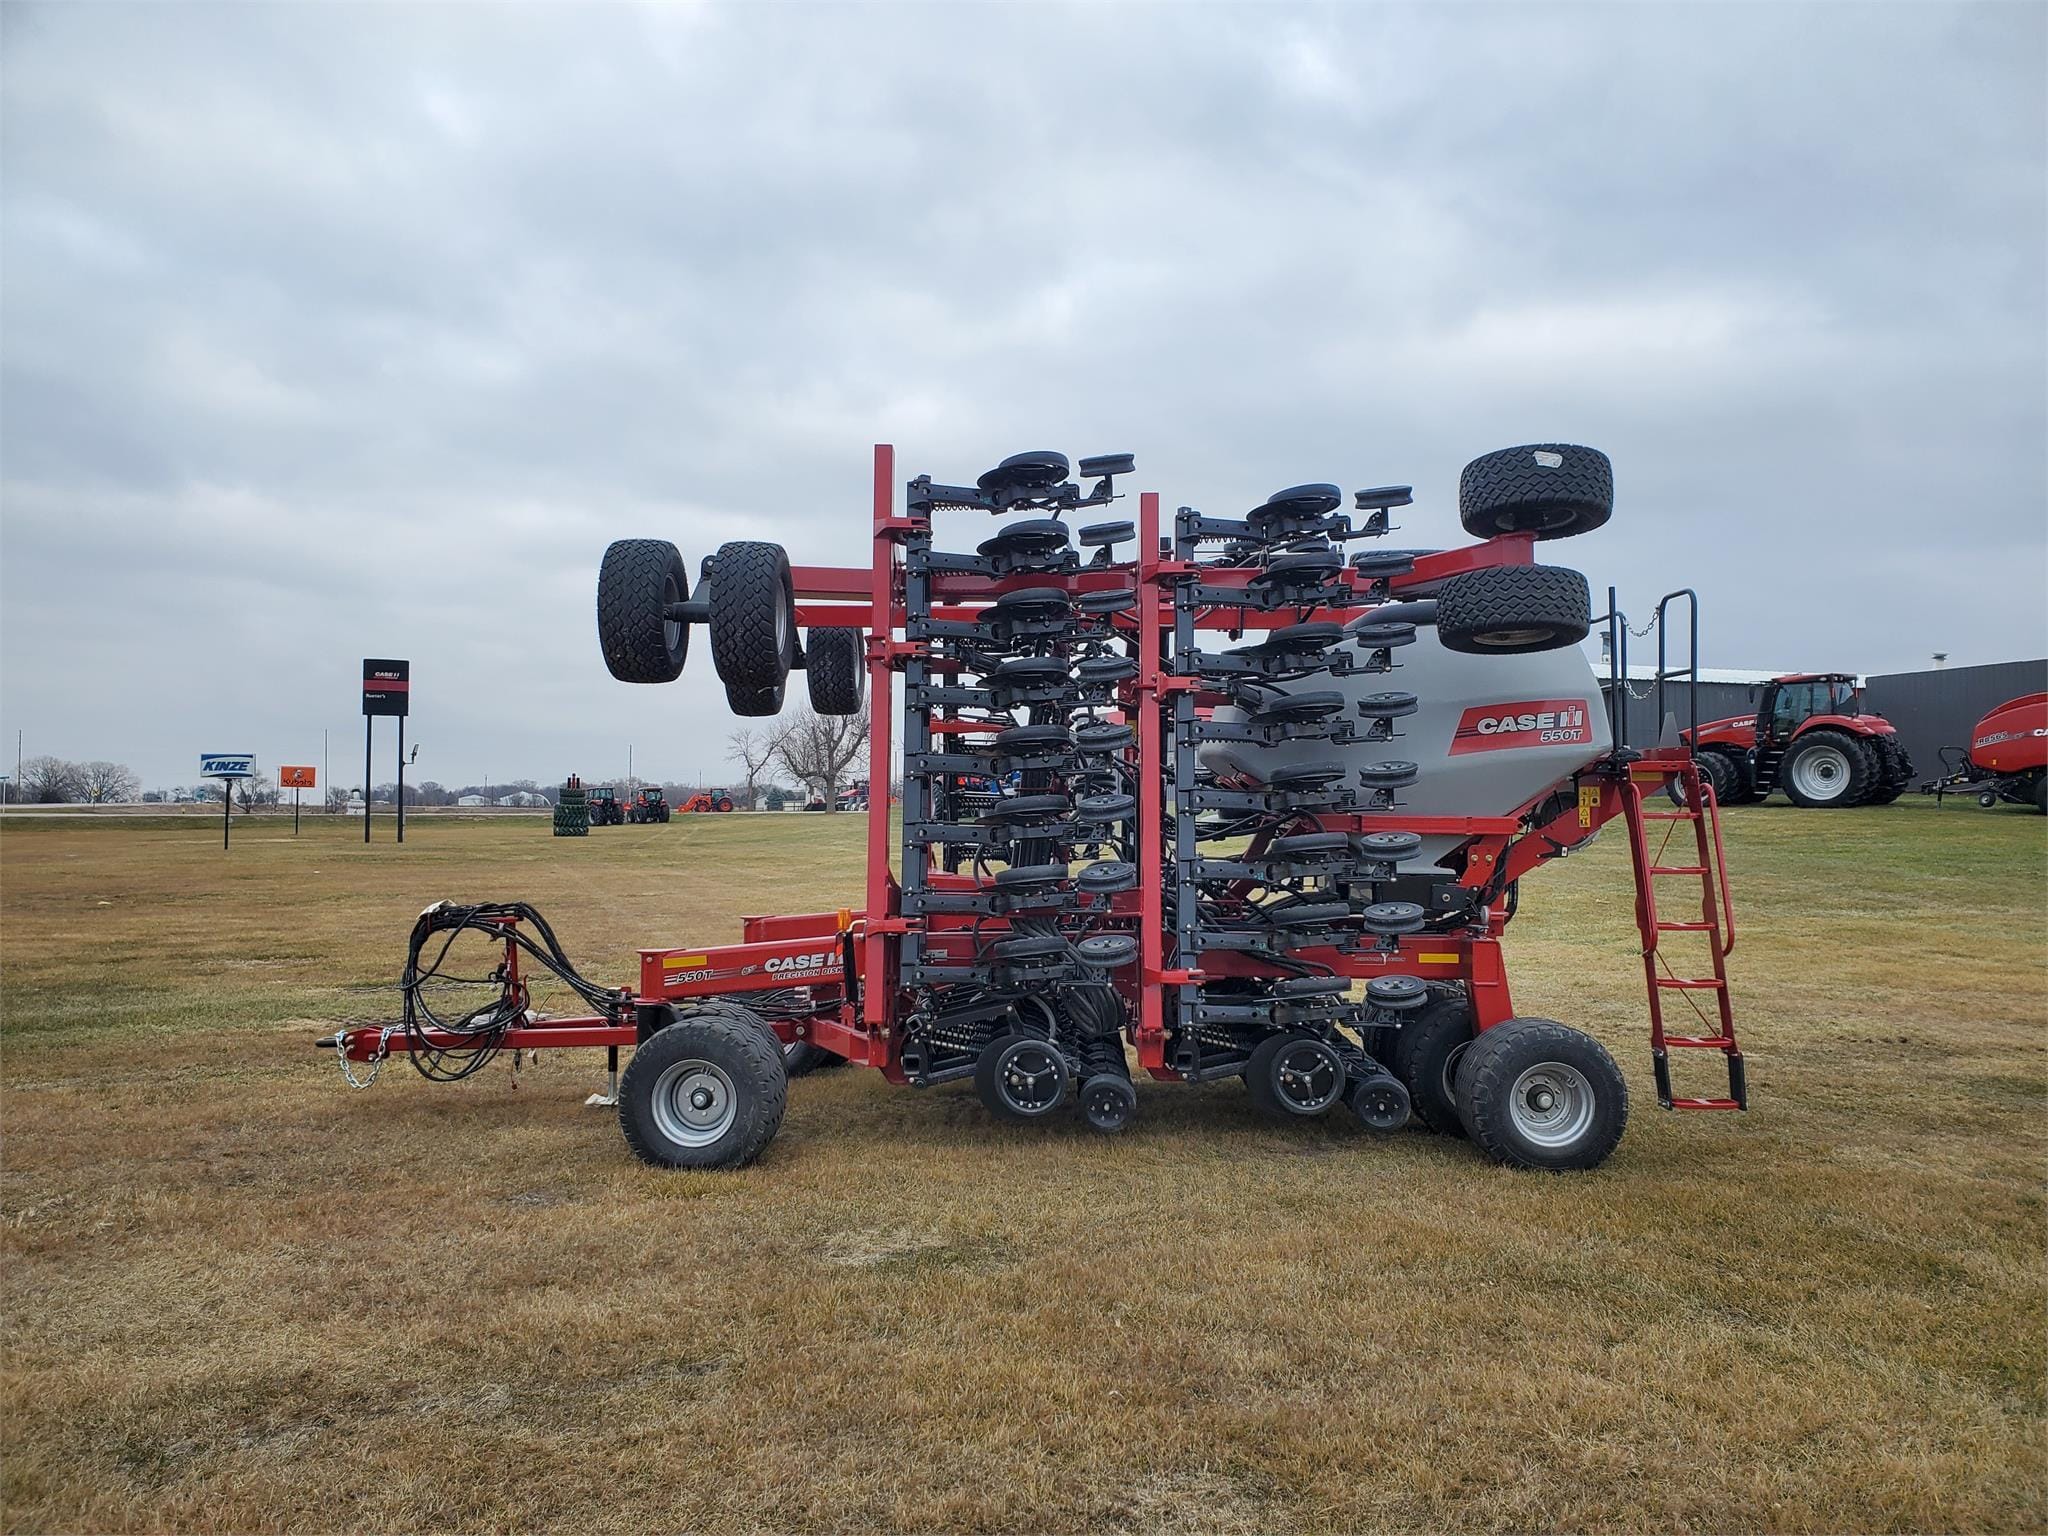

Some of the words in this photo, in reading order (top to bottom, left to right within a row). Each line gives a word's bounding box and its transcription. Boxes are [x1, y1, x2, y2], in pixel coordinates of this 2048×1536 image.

[1477, 712, 1555, 734] CASE
[1540, 729, 1583, 743] 550T
[203, 761, 250, 771] KINZE
[283, 778, 313, 786] Kubota
[764, 953, 825, 973] CASE
[676, 969, 714, 983] 550T
[771, 969, 820, 981] PRECISION
[822, 965, 845, 976] DISK
